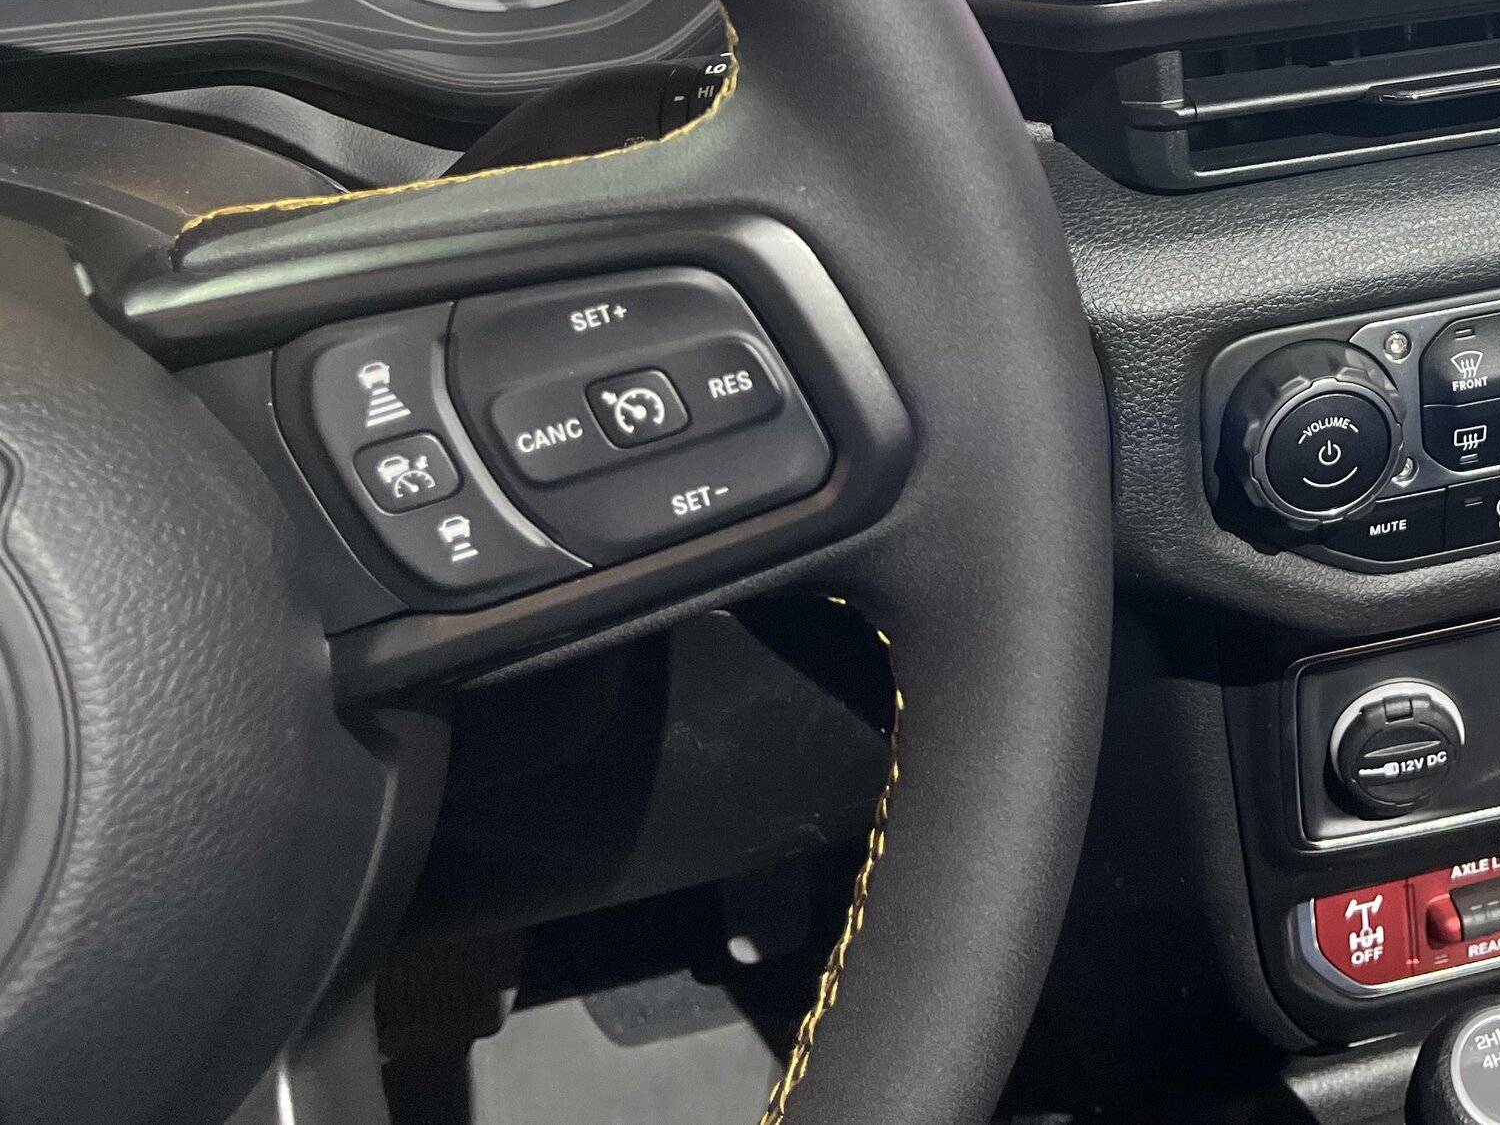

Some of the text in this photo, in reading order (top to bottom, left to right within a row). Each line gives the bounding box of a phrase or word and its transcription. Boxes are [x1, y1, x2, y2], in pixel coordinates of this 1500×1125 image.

[705, 63, 727, 75] LO
[698, 85, 714, 99] HI
[571, 303, 628, 333] SET+
[708, 371, 753, 399] RES
[1452, 376, 1489, 392] FRONT
[1305, 417, 1351, 437] VOLUME
[517, 420, 585, 454] CANC
[1369, 519, 1408, 536] MUTE
[1401, 751, 1447, 773] 12V DC
[1451, 858, 1489, 879] AXLE
[1351, 946, 1384, 964] OFF
[1475, 1031, 1498, 1050] 2H
